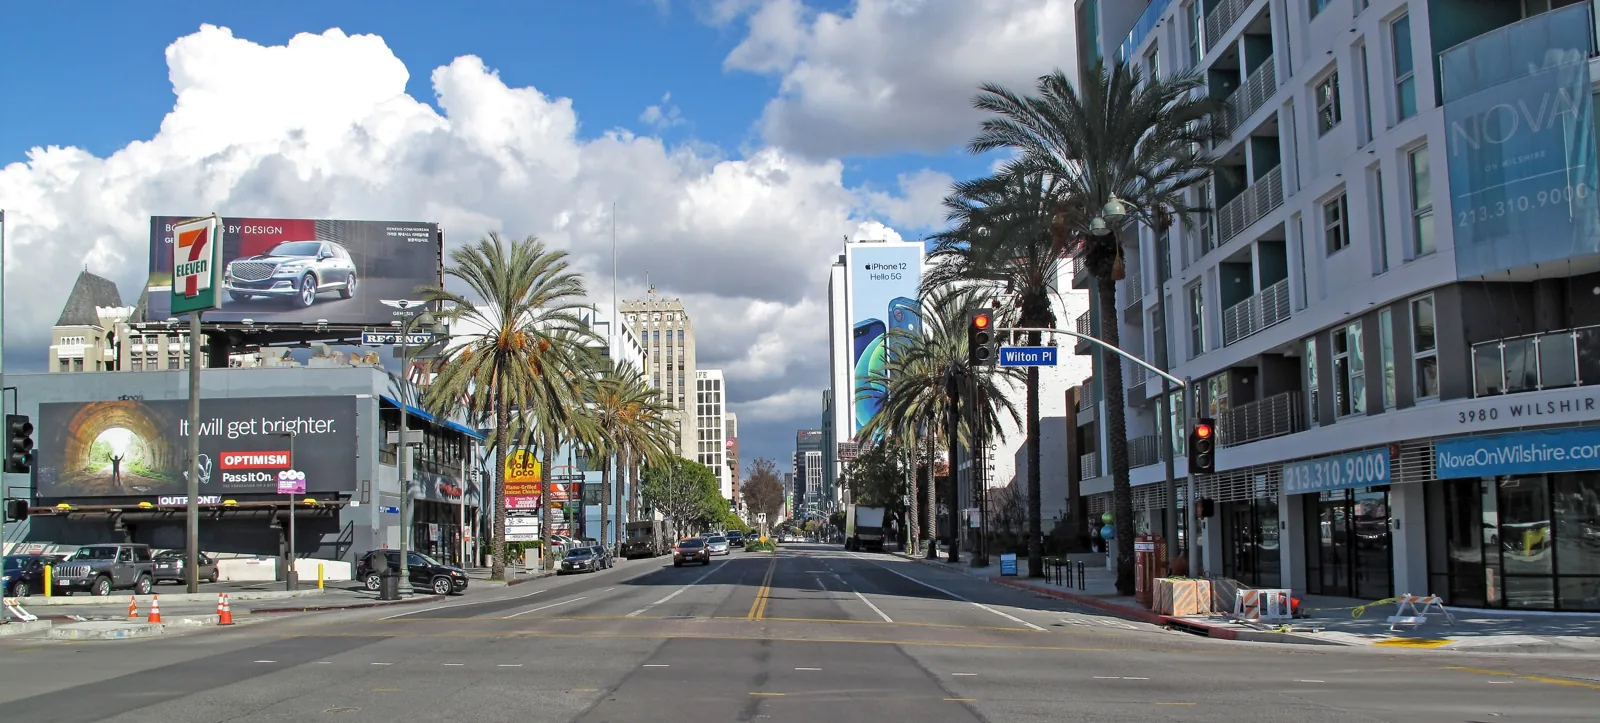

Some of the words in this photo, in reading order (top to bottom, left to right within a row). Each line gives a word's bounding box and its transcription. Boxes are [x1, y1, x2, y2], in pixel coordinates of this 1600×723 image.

[1452, 87, 1579, 157] NOVA
[1485, 163, 1498, 172] ON
[1502, 151, 1546, 167] WILSHIRE
[1459, 183, 1588, 227] 213.310.9000
[229, 225, 242, 234] BY
[244, 225, 284, 235] DESIGN
[179, 226, 208, 298] 7
[899, 262, 907, 270] 12
[366, 334, 432, 343] REGENCY
[1006, 351, 1038, 362] Wilton
[1042, 351, 1052, 362] Pl
[1458, 407, 1499, 424] 3980
[1510, 397, 1594, 417] WILSHIR
[180, 419, 190, 436] It
[198, 418, 223, 436] will
[227, 418, 258, 439] get
[262, 416, 337, 438] brighter.
[224, 455, 287, 466] OPTIMISM
[1286, 453, 1385, 490] 213.310.9000
